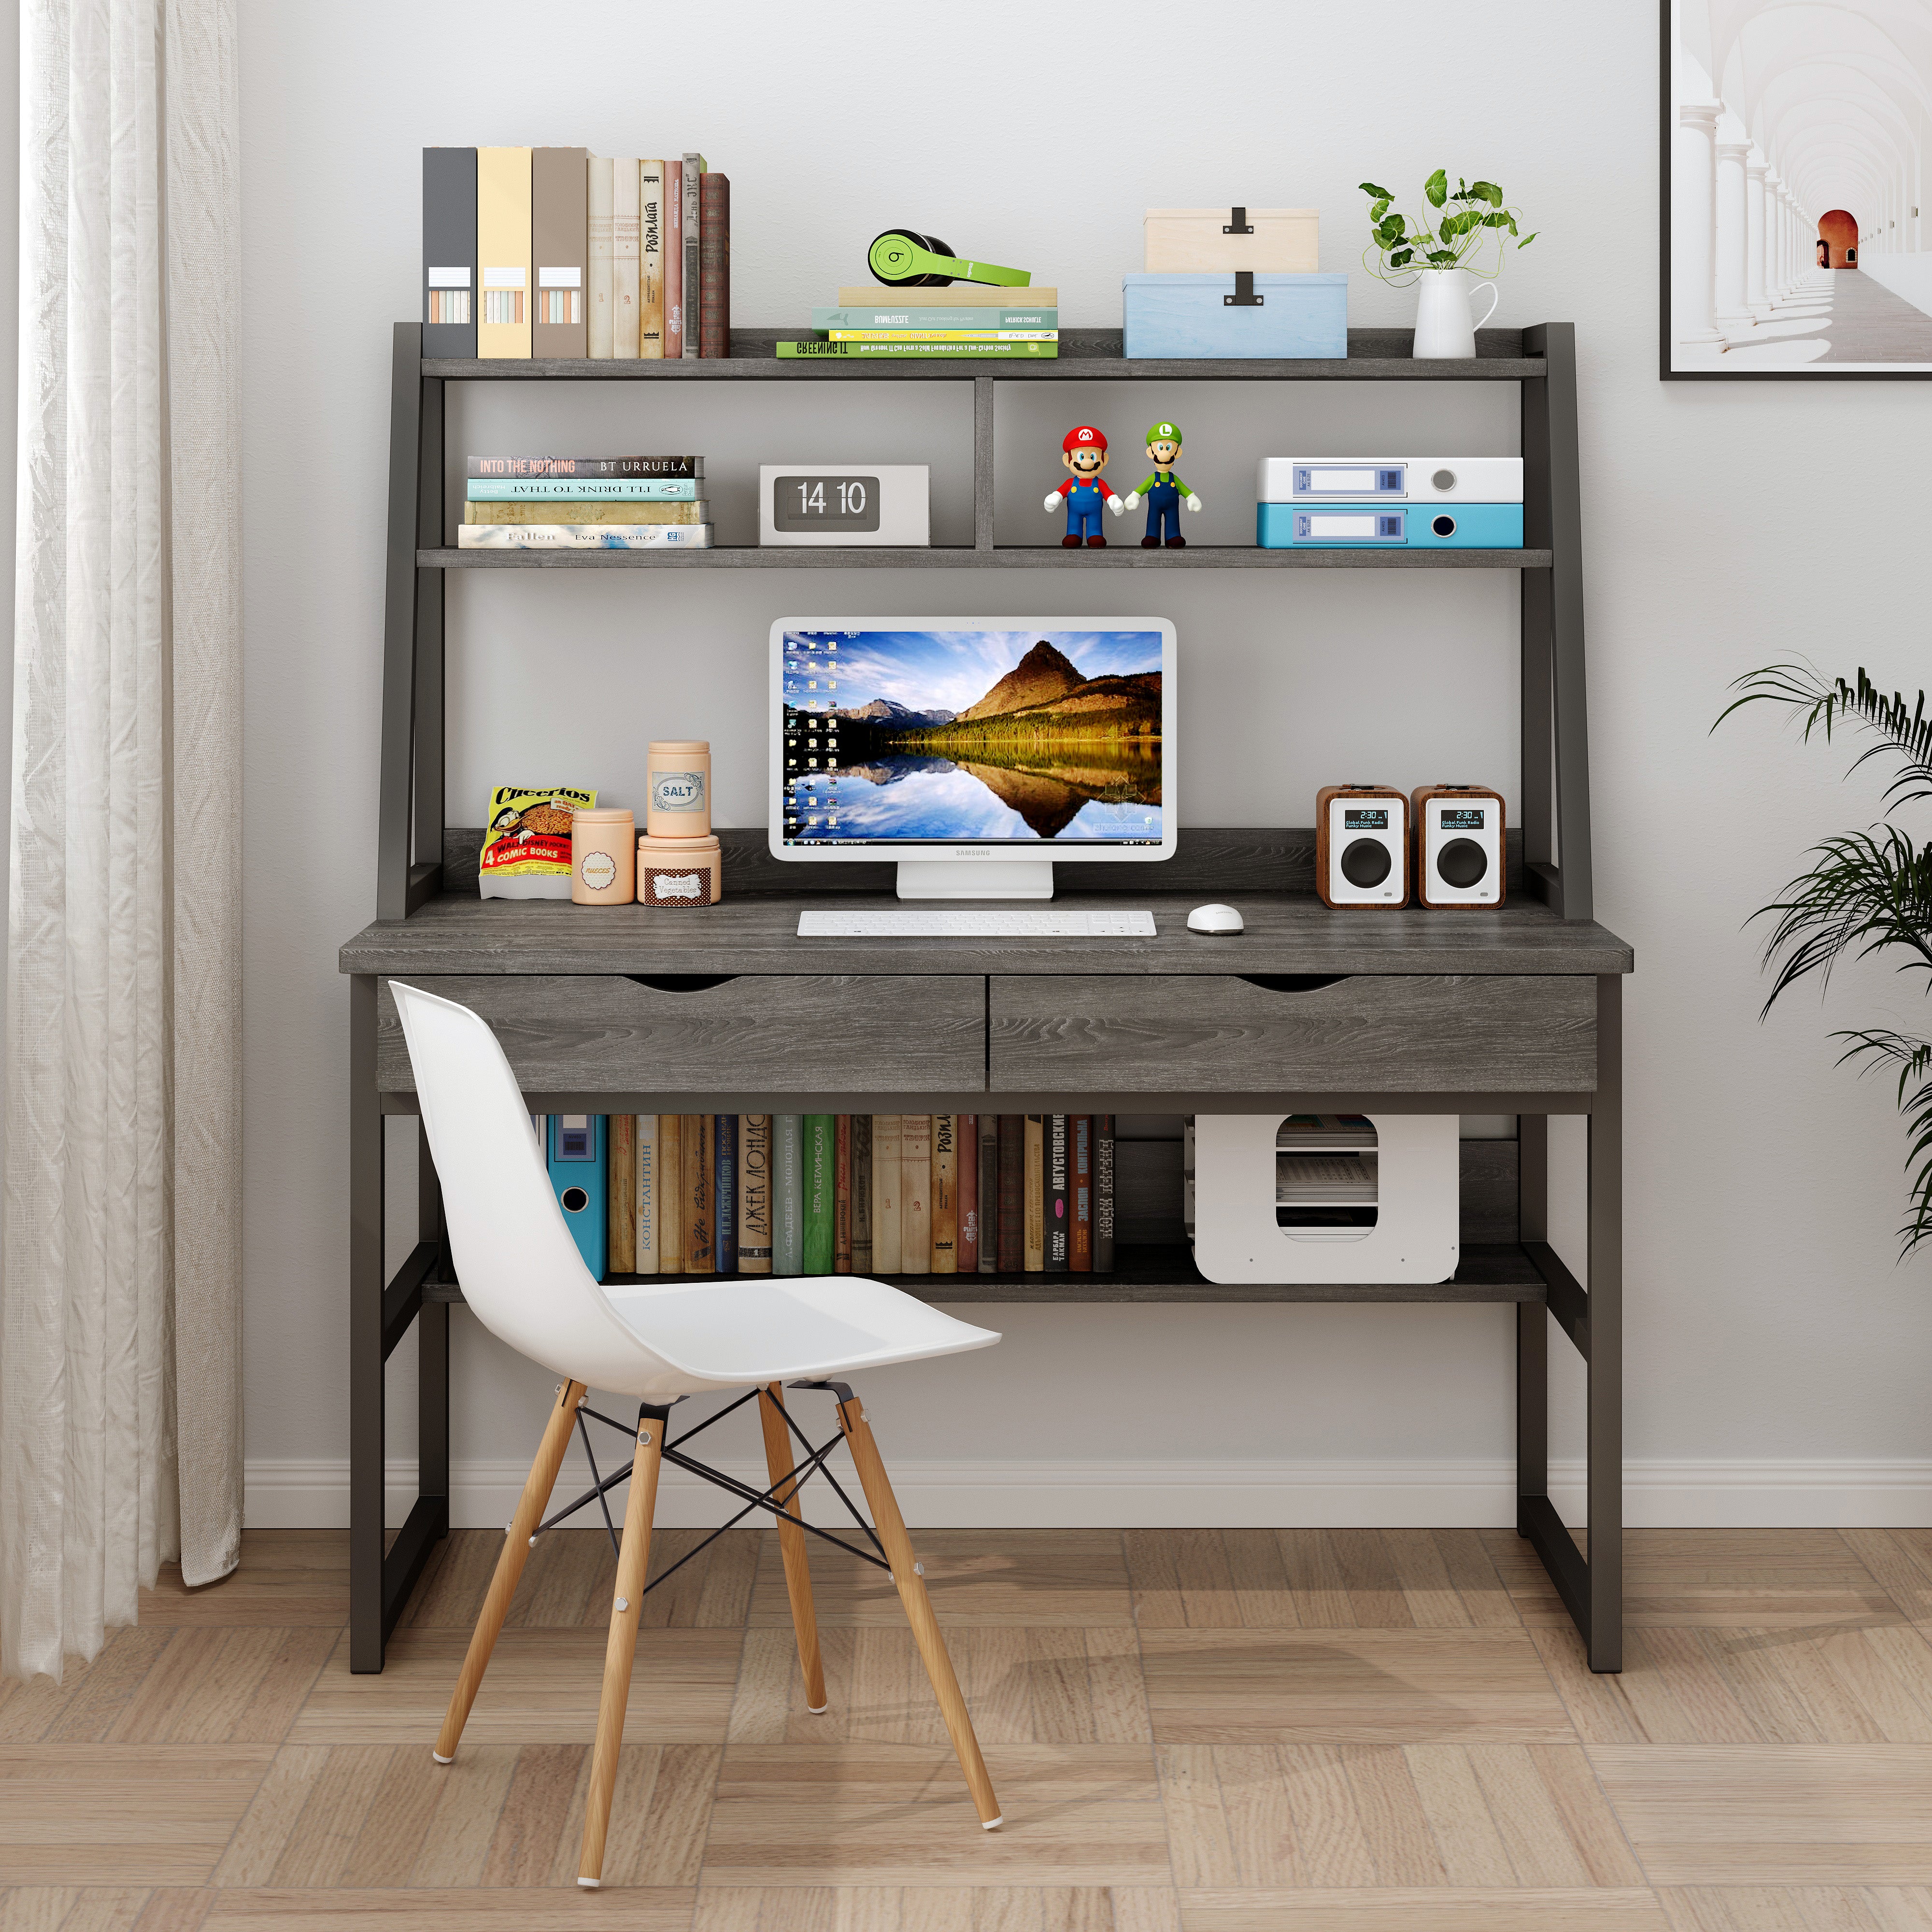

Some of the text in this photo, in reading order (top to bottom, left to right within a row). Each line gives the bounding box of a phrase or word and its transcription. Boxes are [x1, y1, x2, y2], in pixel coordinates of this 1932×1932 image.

[598, 293, 604, 302] 1
[624, 295, 631, 304] 2
[1163, 426, 1170, 434] L
[480, 460, 575, 473] INTO THE NOTHING
[600, 462, 688, 471] BT URRUELA
[797, 482, 866, 513] 14 10
[506, 532, 555, 540] Fallen
[496, 787, 590, 805] Cheerios
[663, 786, 693, 796] SALT
[485, 850, 495, 866] 4
[497, 847, 527, 862] COMIC
[530, 847, 558, 858] BOOKS
[785, 1128, 794, 1187] МОЛОДАЯ
[814, 1126, 823, 1189] КЕТЛИНСКАЯ
[1099, 1139, 1114, 1194] ЛЕГЕНД
[1077, 1119, 1088, 1222] ЗАСЛОН КОНТРОЛЬНА
[642, 1145, 651, 1250] КОНСТАНТИН
[885, 1198, 891, 1208] 1
[913, 1201, 921, 1211] 2
[746, 1184, 767, 1236] ДЖЕК
[1099, 1198, 1114, 1239] ЛЮДИ
